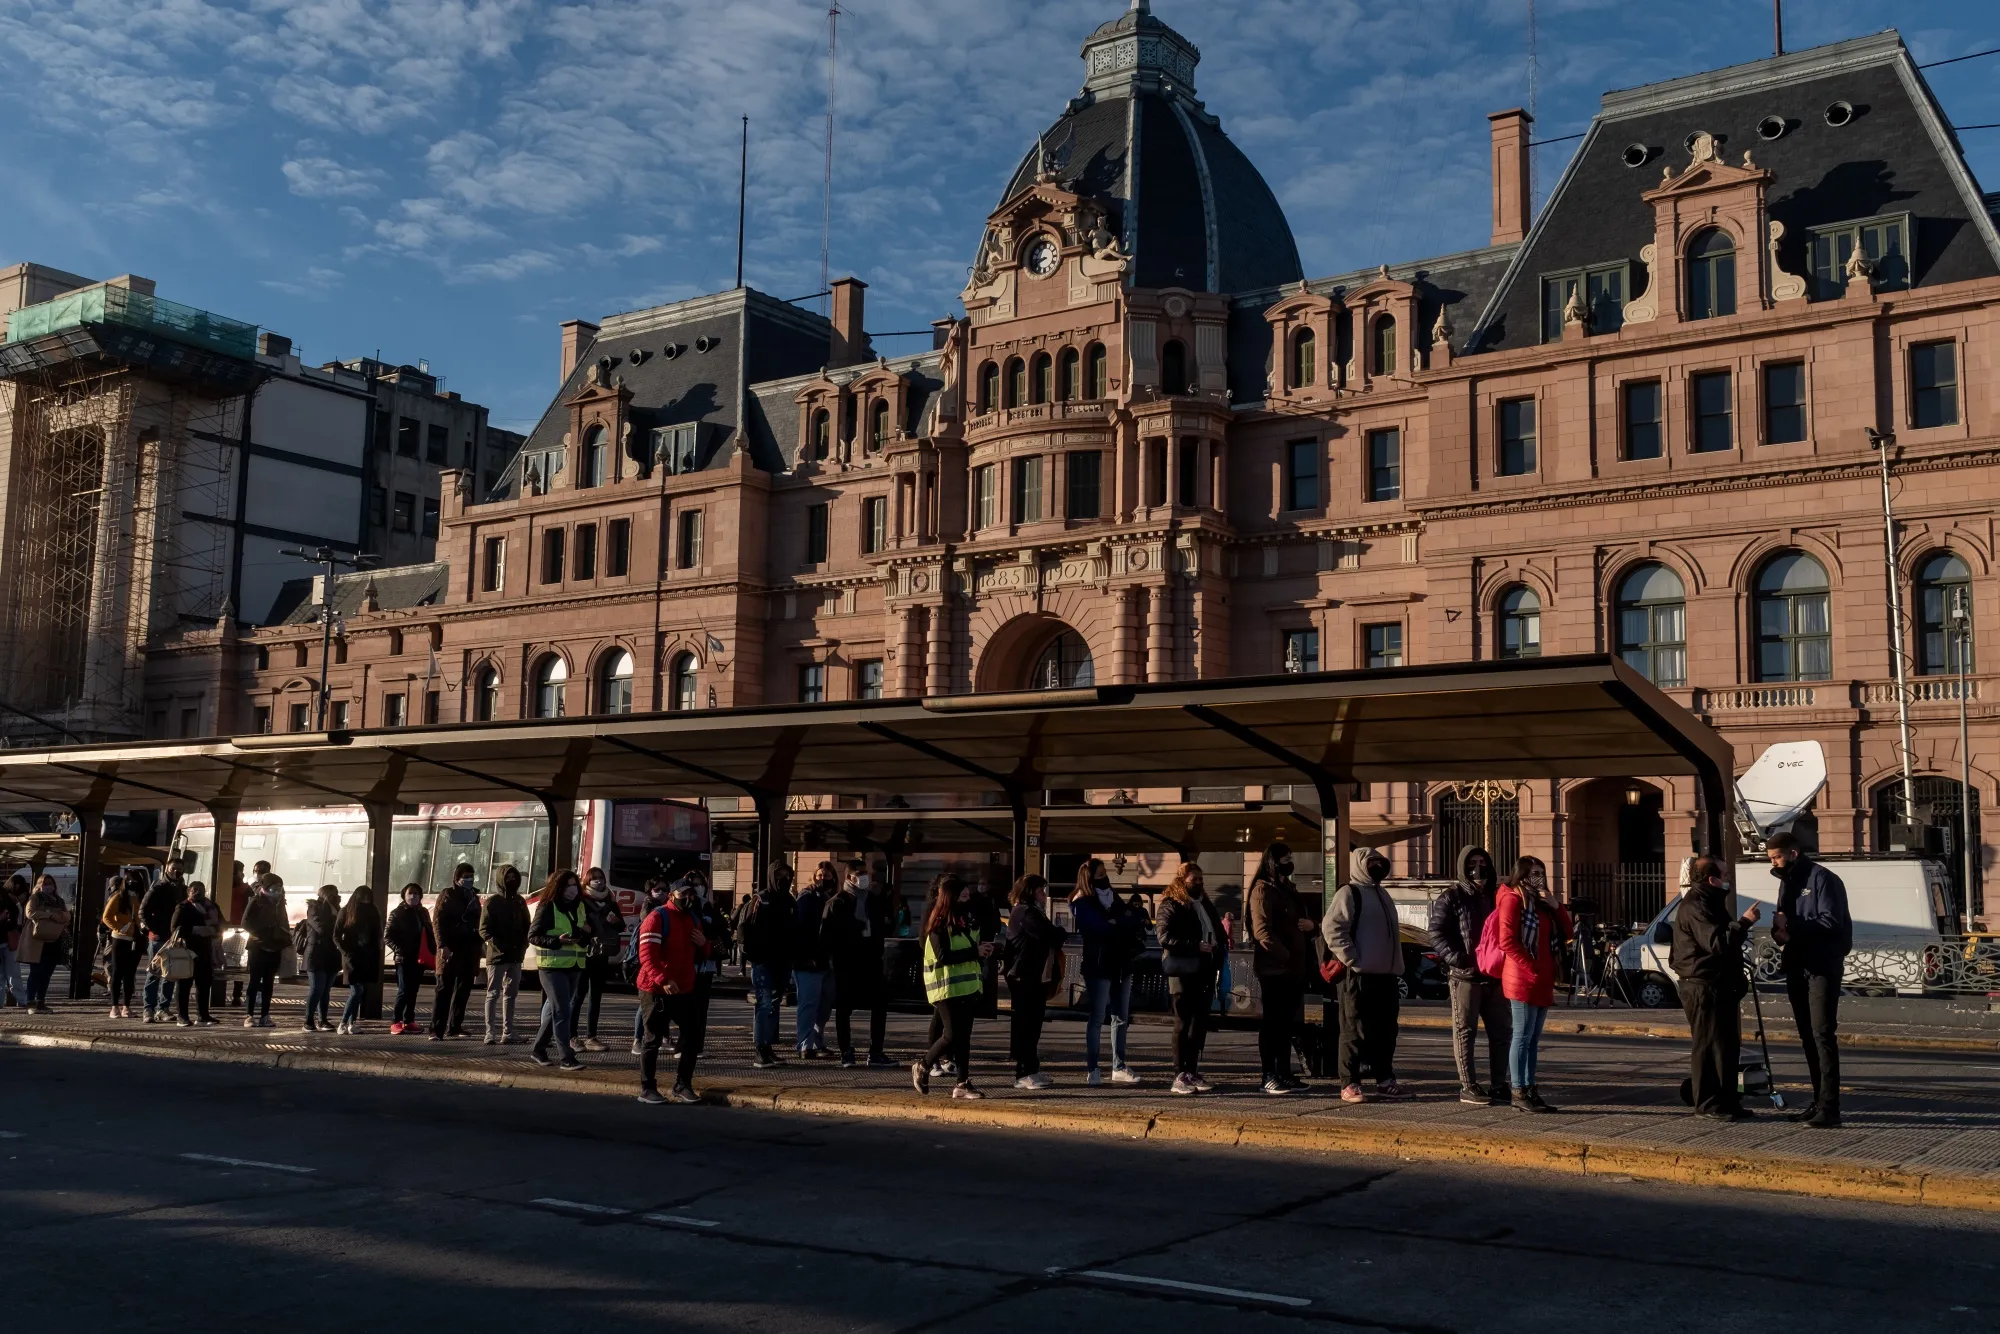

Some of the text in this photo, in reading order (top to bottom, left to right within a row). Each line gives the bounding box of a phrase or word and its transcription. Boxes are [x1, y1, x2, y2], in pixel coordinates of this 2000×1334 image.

[980, 568, 1022, 588] 1885
[1047, 561, 1089, 581] 1907
[1029, 836, 1038, 846] 59
